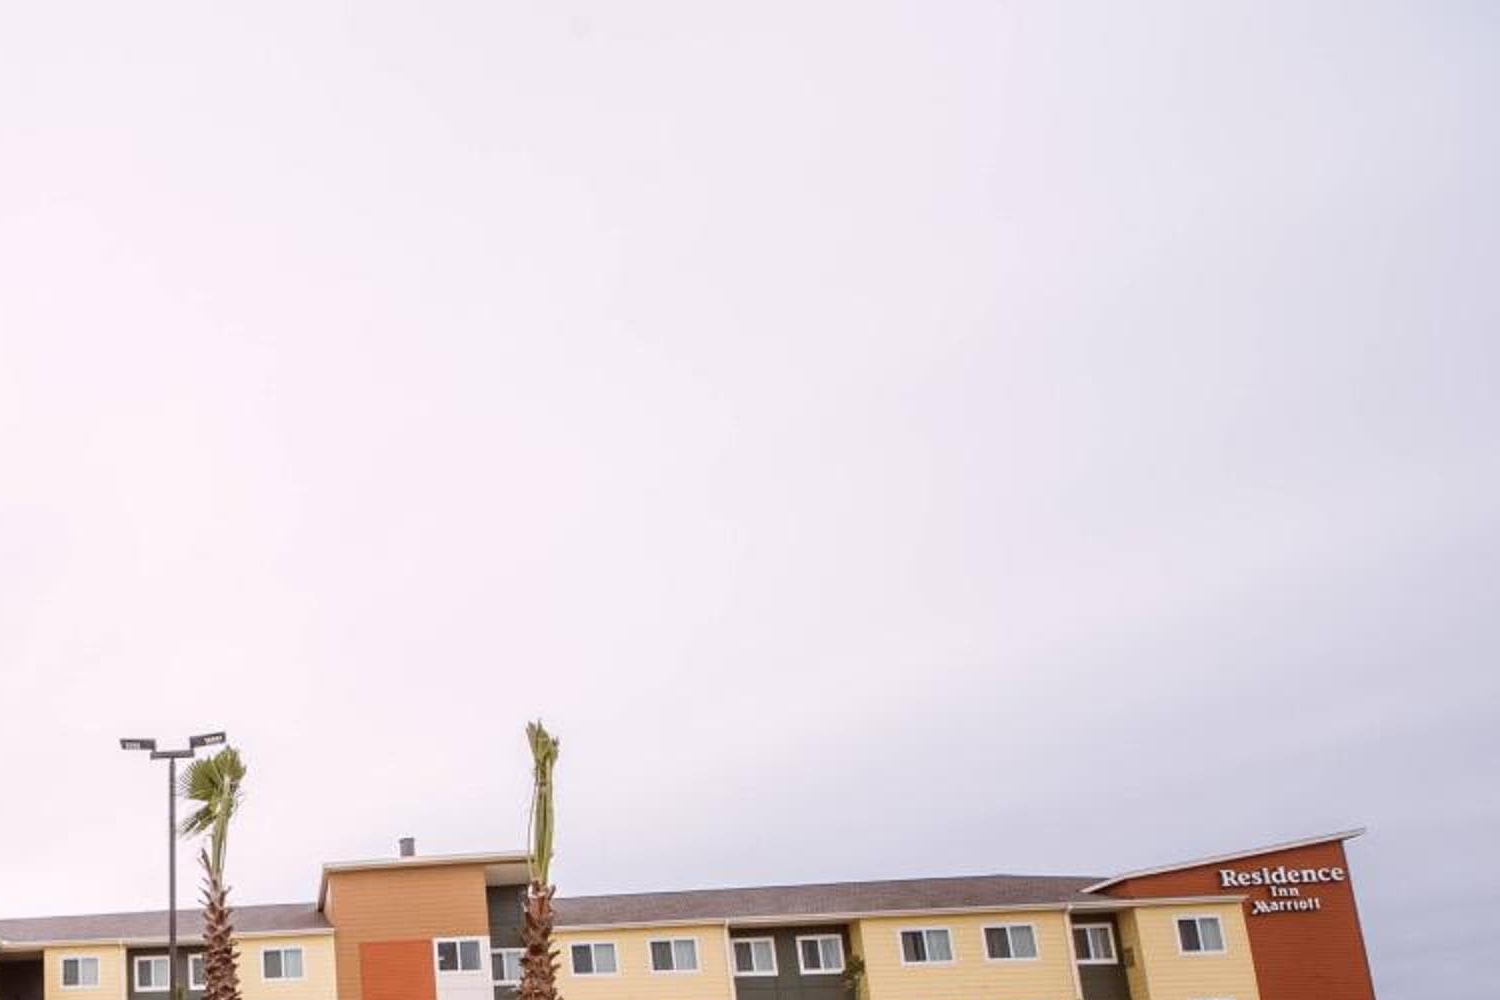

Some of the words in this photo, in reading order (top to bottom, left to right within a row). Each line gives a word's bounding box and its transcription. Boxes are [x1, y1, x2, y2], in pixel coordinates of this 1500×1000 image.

[1219, 865, 1345, 888] Residence
[1270, 885, 1300, 897] Inn
[1252, 897, 1321, 915] Marriott
